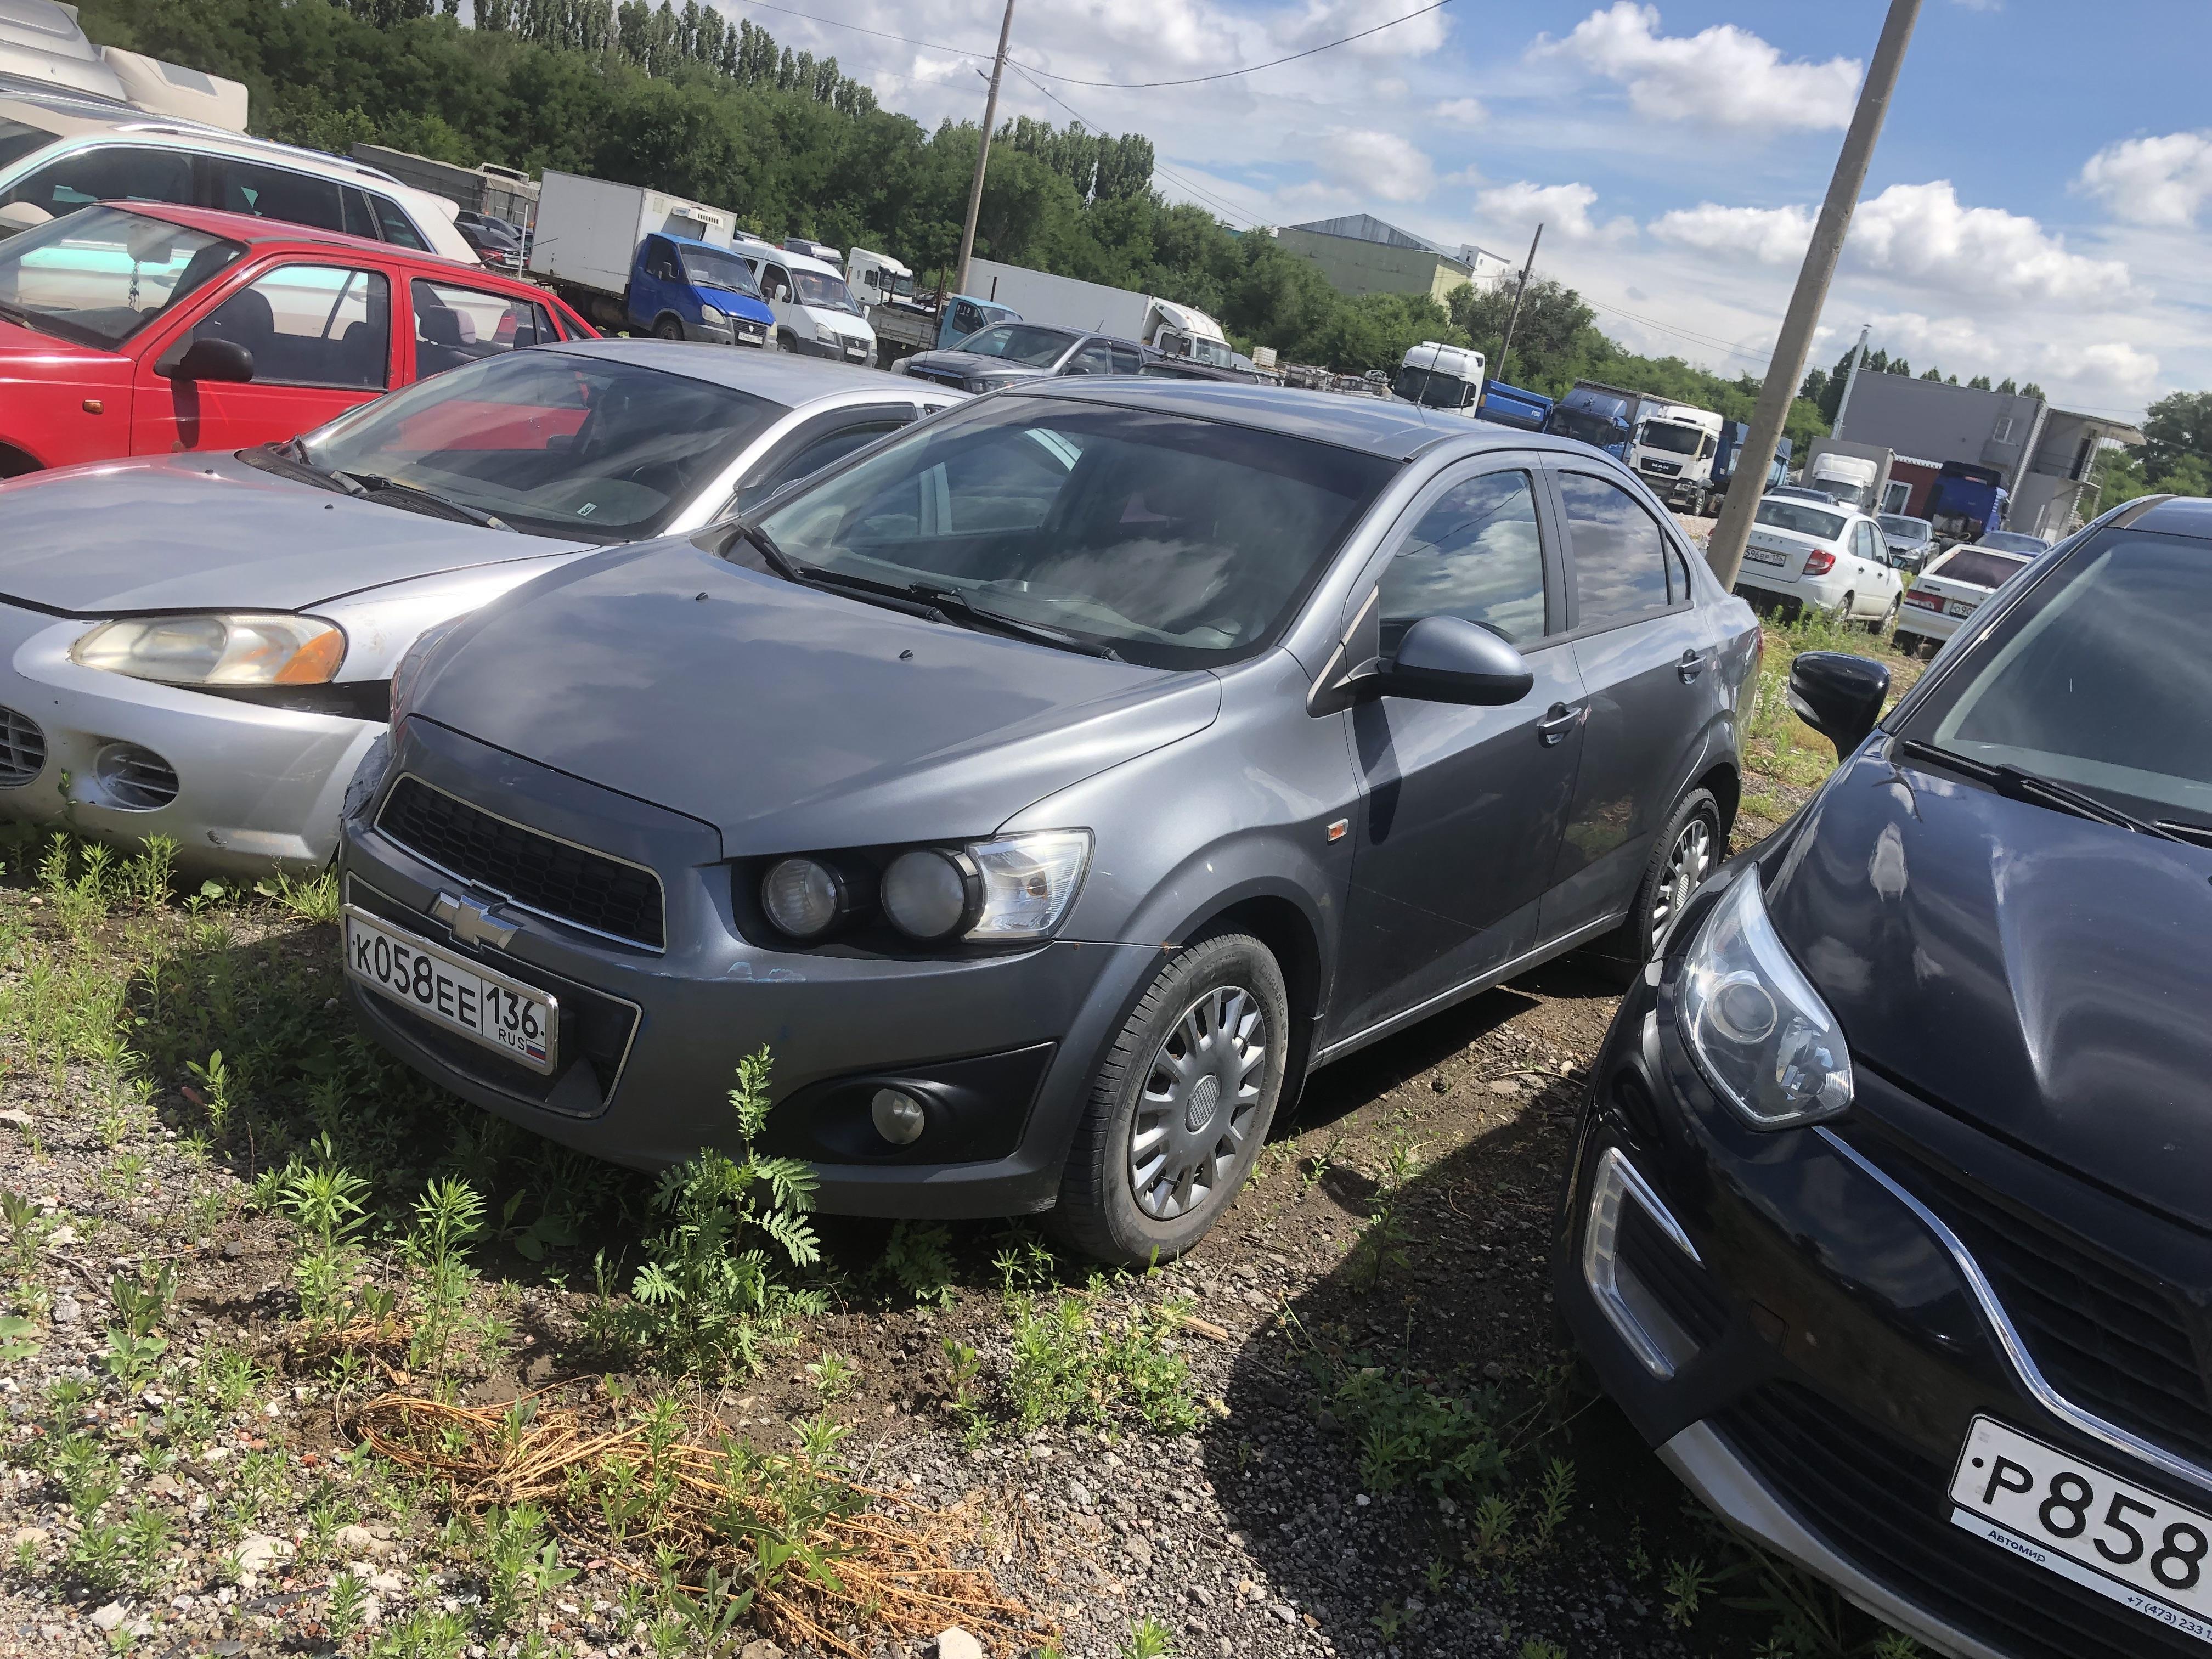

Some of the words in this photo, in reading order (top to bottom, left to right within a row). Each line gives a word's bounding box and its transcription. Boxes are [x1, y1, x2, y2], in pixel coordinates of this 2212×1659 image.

[486, 987, 538, 1040] 136
[499, 1028, 526, 1051] RUS
[1987, 1530, 2046, 1562] Автомир
[2127, 1596, 2144, 1606] +7
[2145, 1603, 2176, 1624] (473)
[2178, 1618, 2203, 1635] 233
